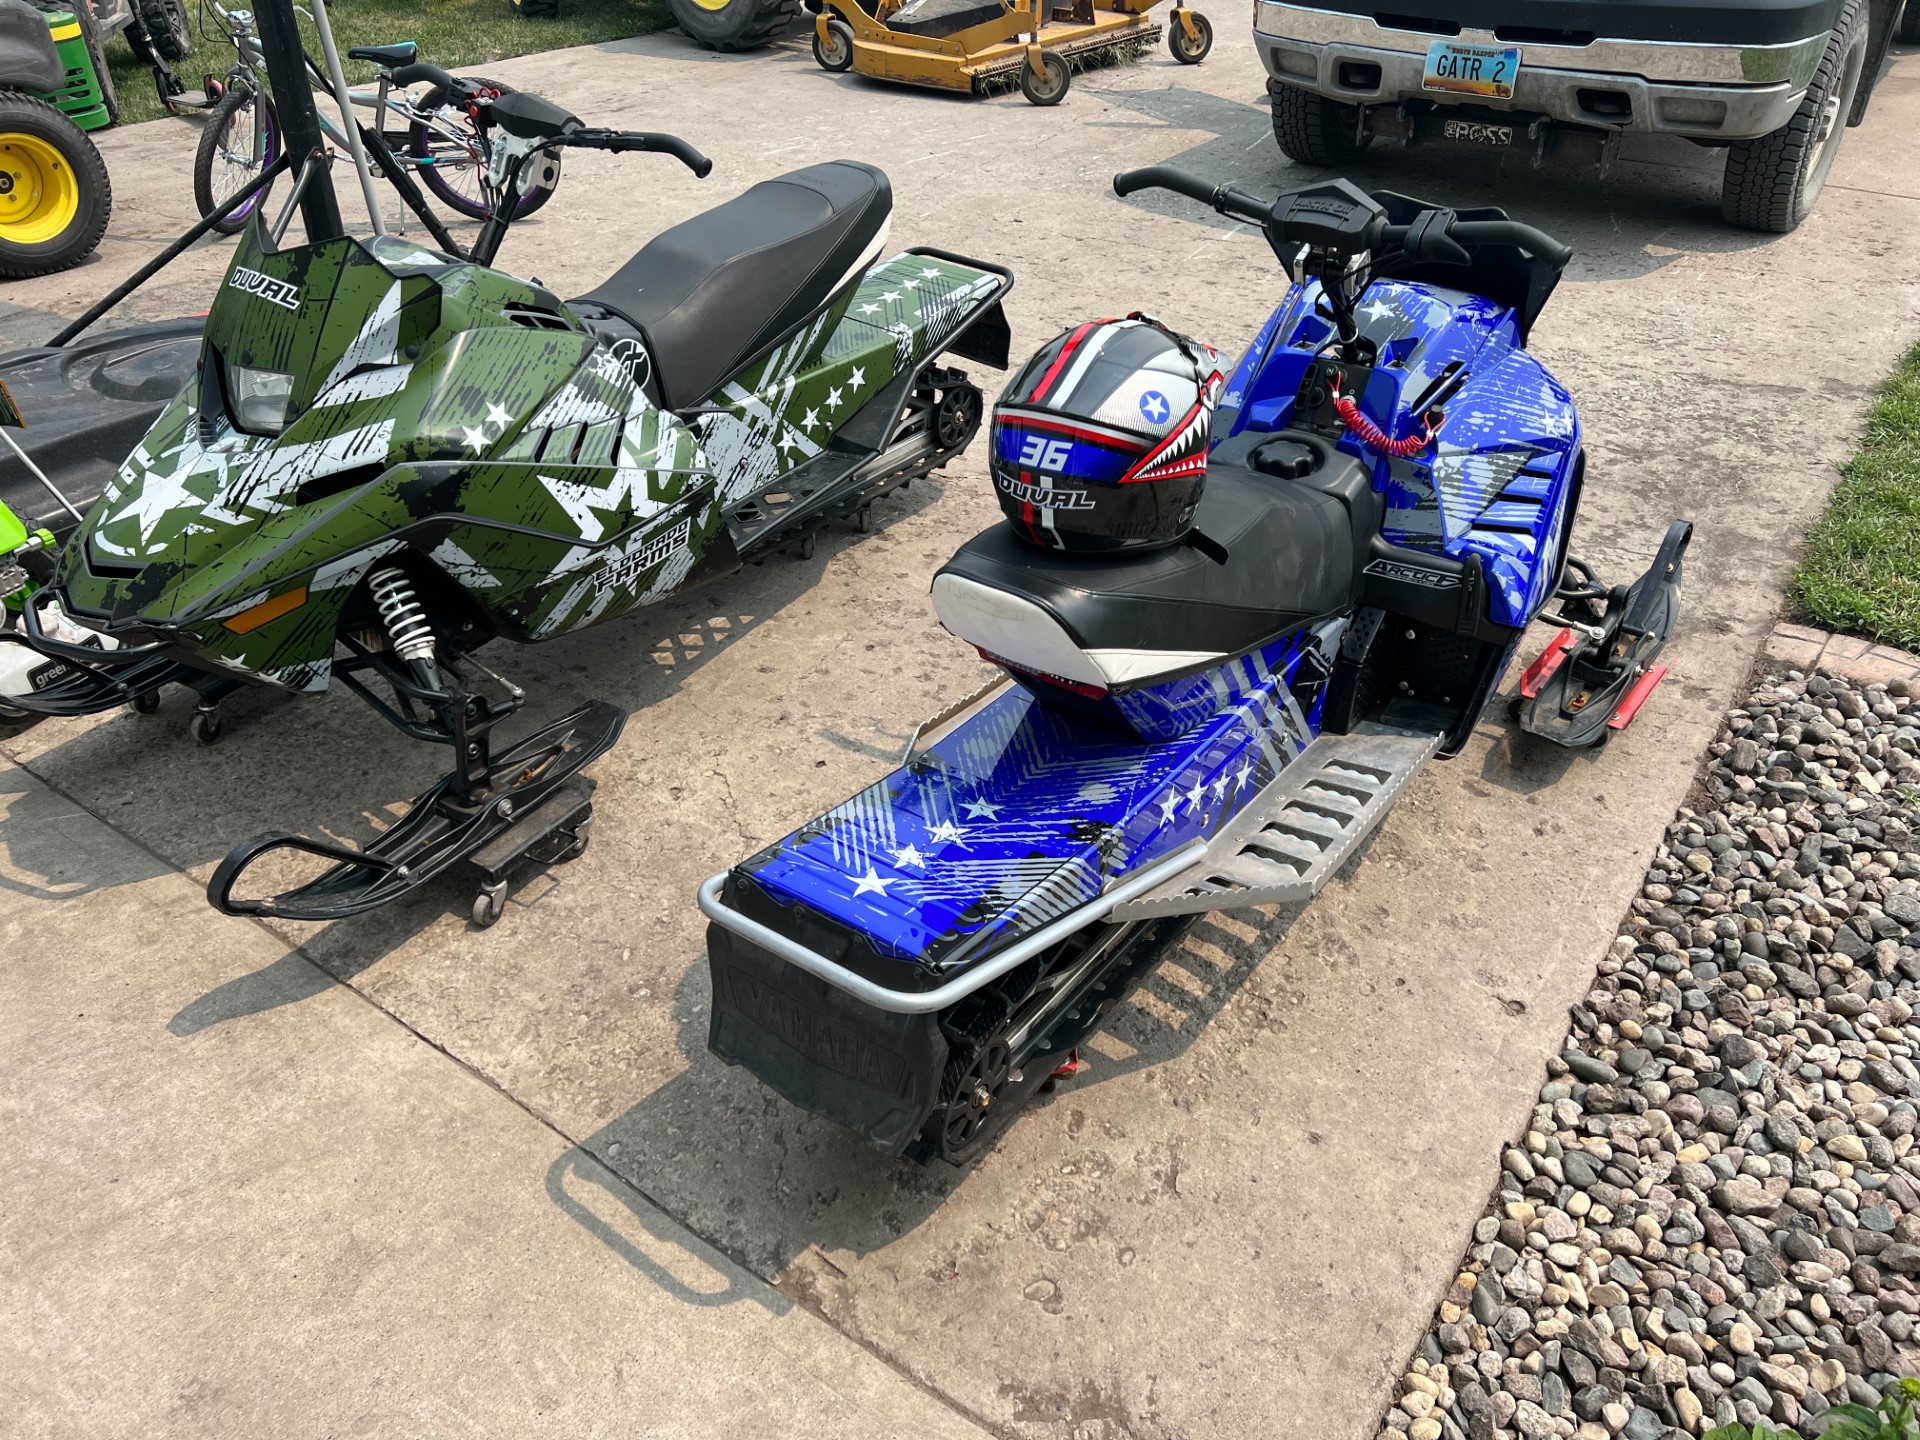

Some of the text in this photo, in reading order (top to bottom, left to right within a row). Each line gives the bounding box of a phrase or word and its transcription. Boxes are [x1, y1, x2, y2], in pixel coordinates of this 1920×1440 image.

[1436, 54, 1506, 84] GATR 2
[229, 266, 300, 310] DUVAL
[1018, 435, 1073, 472] 36
[998, 470, 1097, 511] DUVAL
[596, 532, 688, 596] FARMS
[1365, 560, 1440, 586] ARCTIC
[749, 982, 884, 1088] YAMAHA
